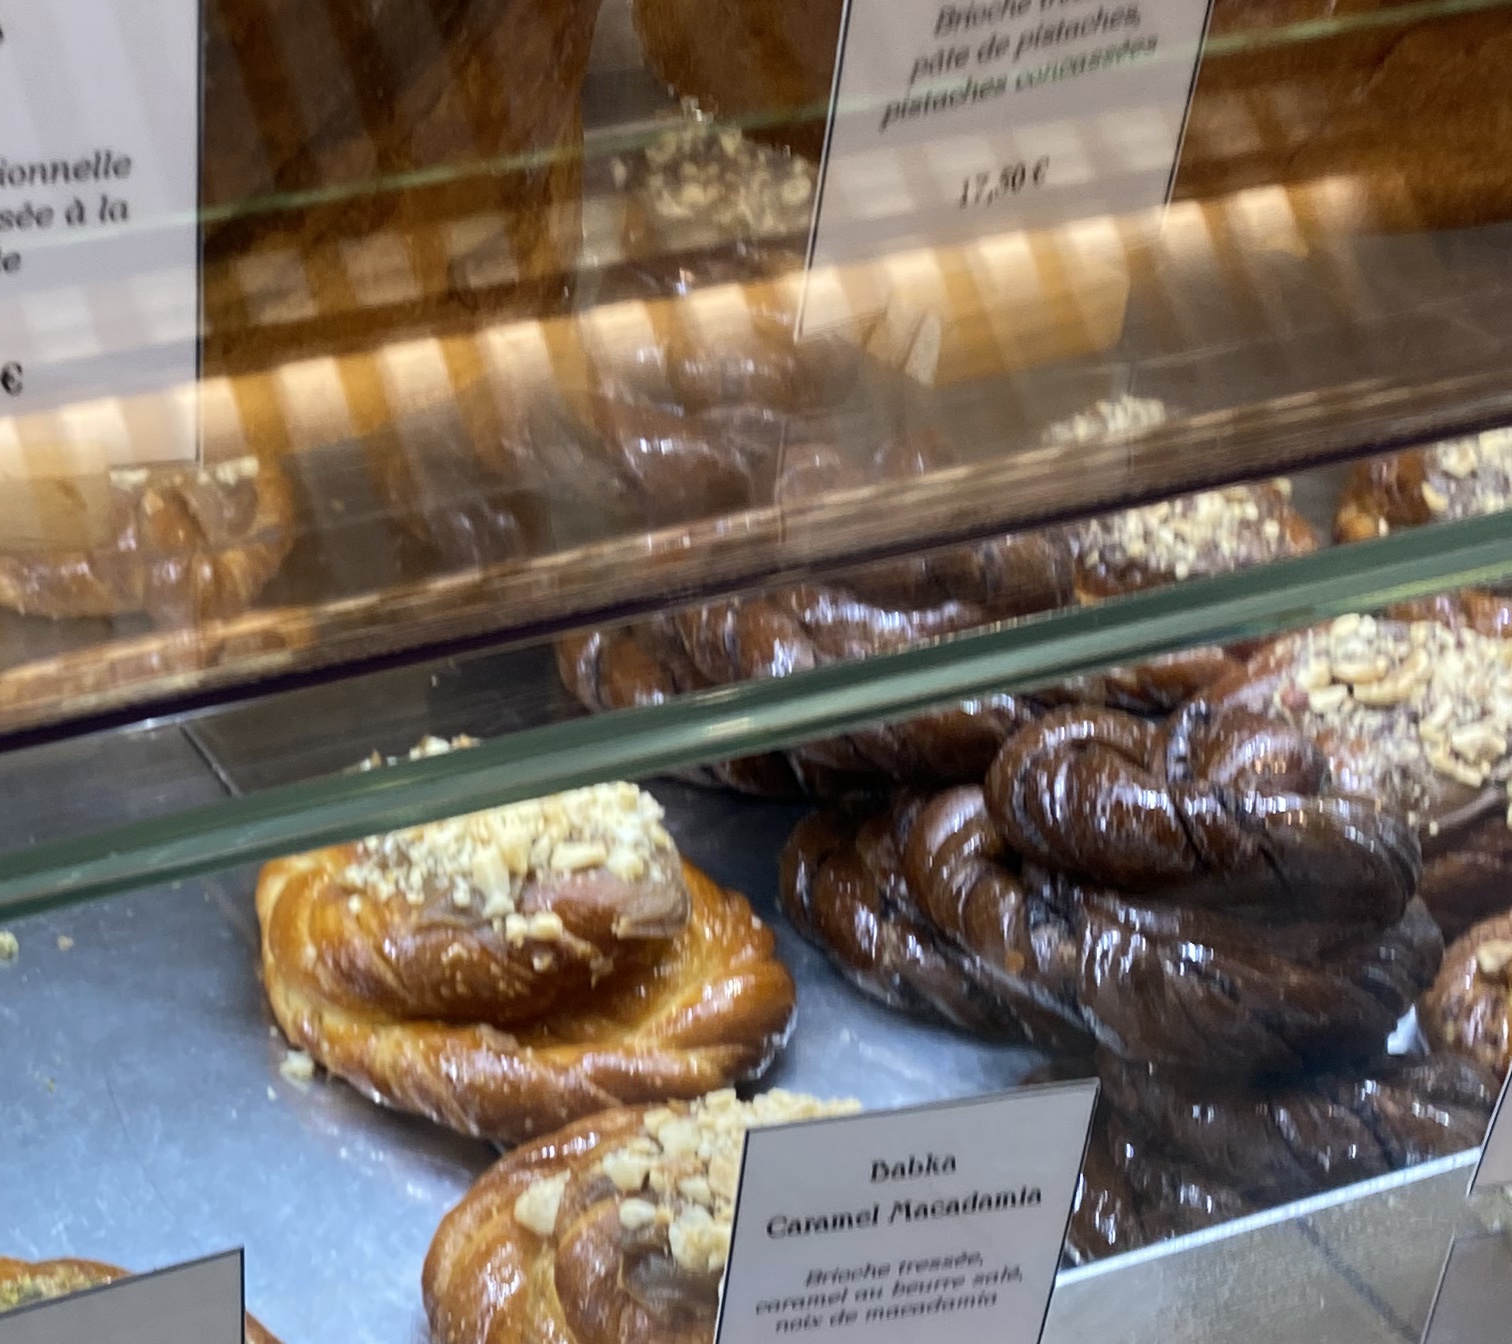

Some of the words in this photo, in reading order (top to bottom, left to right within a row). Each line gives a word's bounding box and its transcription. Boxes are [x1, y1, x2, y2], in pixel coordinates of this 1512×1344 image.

[64, 198, 85, 225] à
[98, 194, 128, 223] la
[0, 364, 21, 394] €
